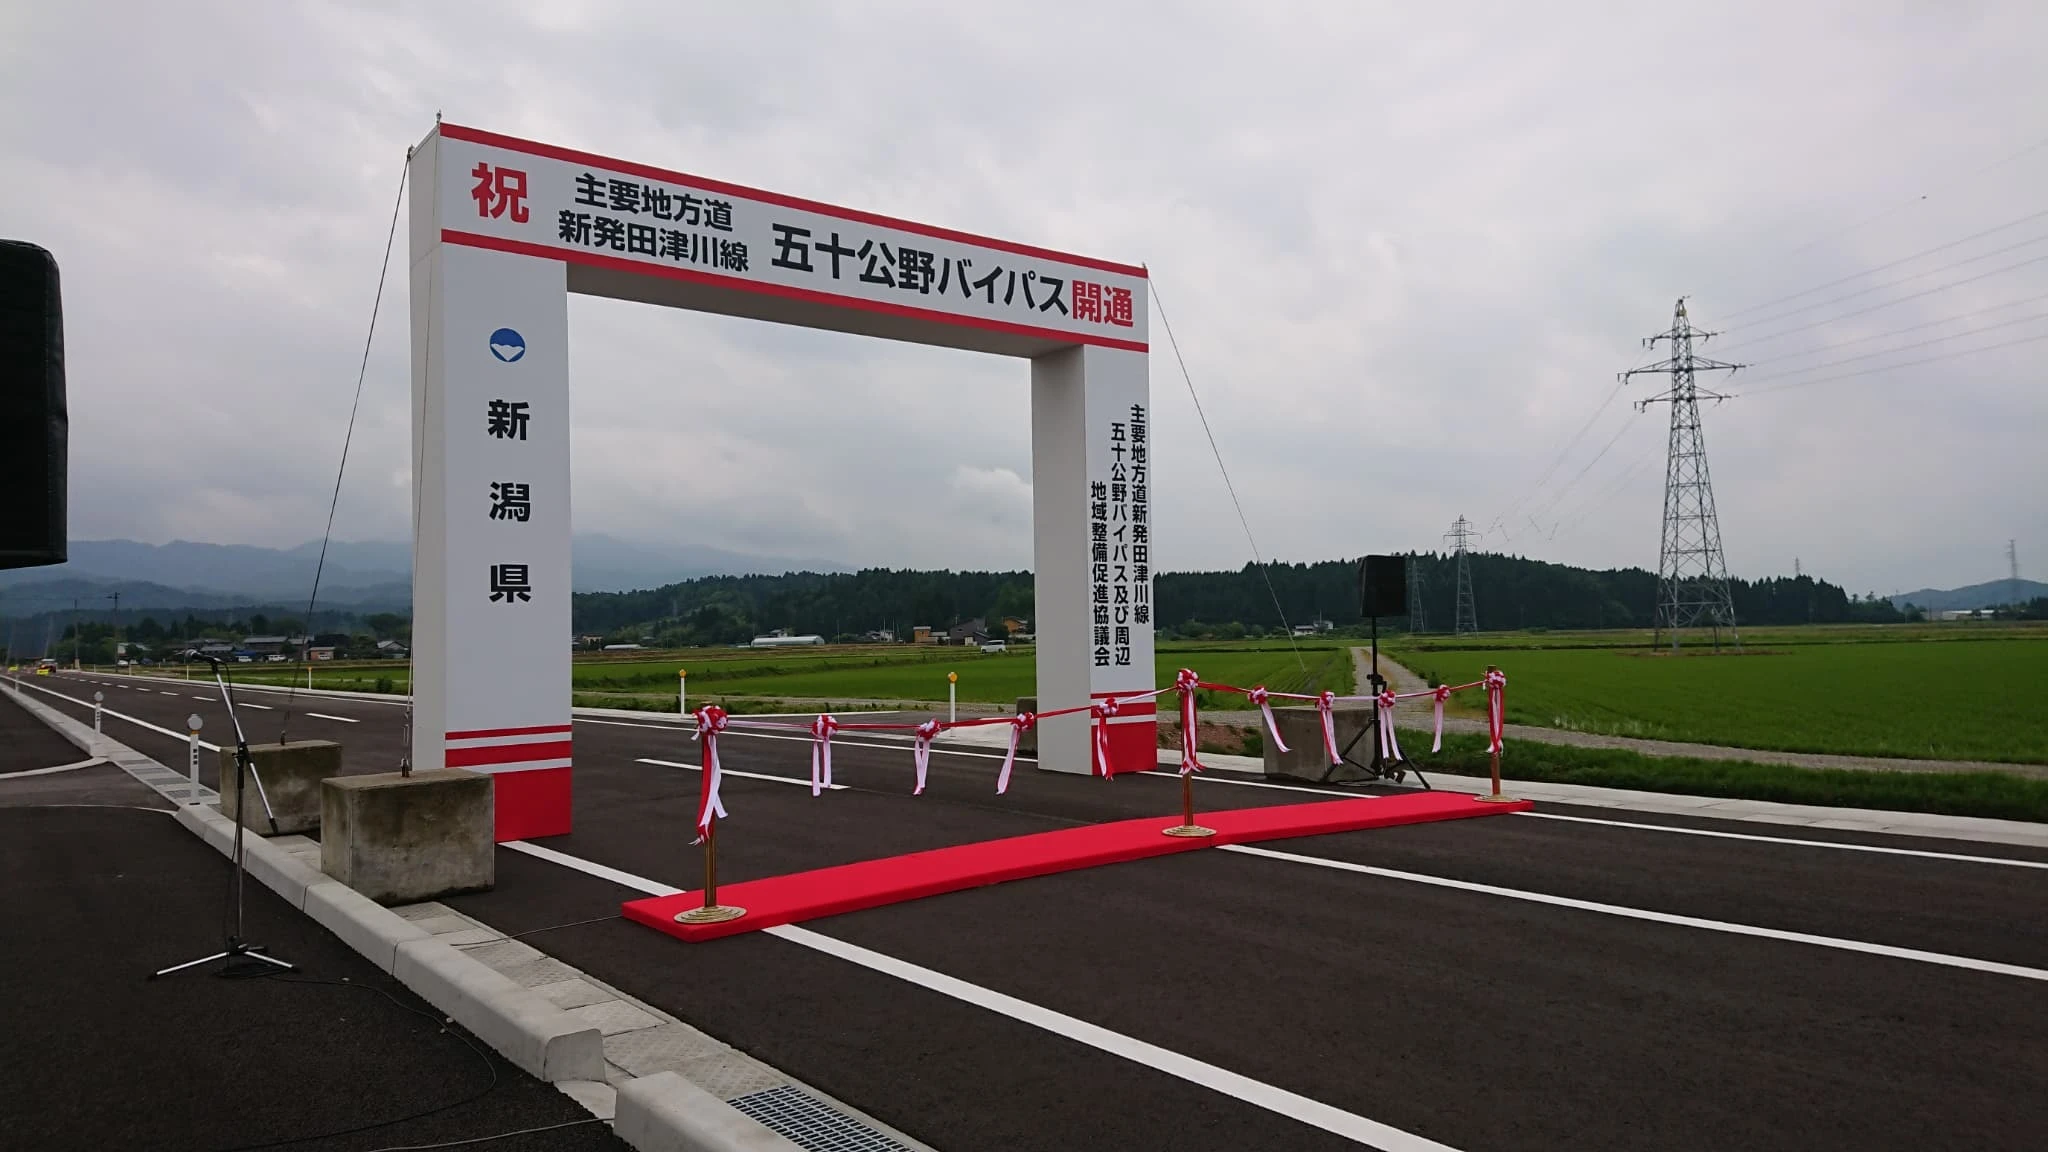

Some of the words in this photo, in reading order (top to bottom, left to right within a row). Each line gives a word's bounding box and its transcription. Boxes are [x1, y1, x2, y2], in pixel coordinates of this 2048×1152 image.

[471, 162, 529, 223] 祝
[558, 209, 748, 272] 新発田津川線
[575, 173, 733, 231] 主要地方道
[1091, 481, 1110, 667] 地域整備促進協議会
[1111, 422, 1131, 666] 五十公野バイパス及び周辺
[1130, 404, 1149, 624] 主要地方道新発田津川線
